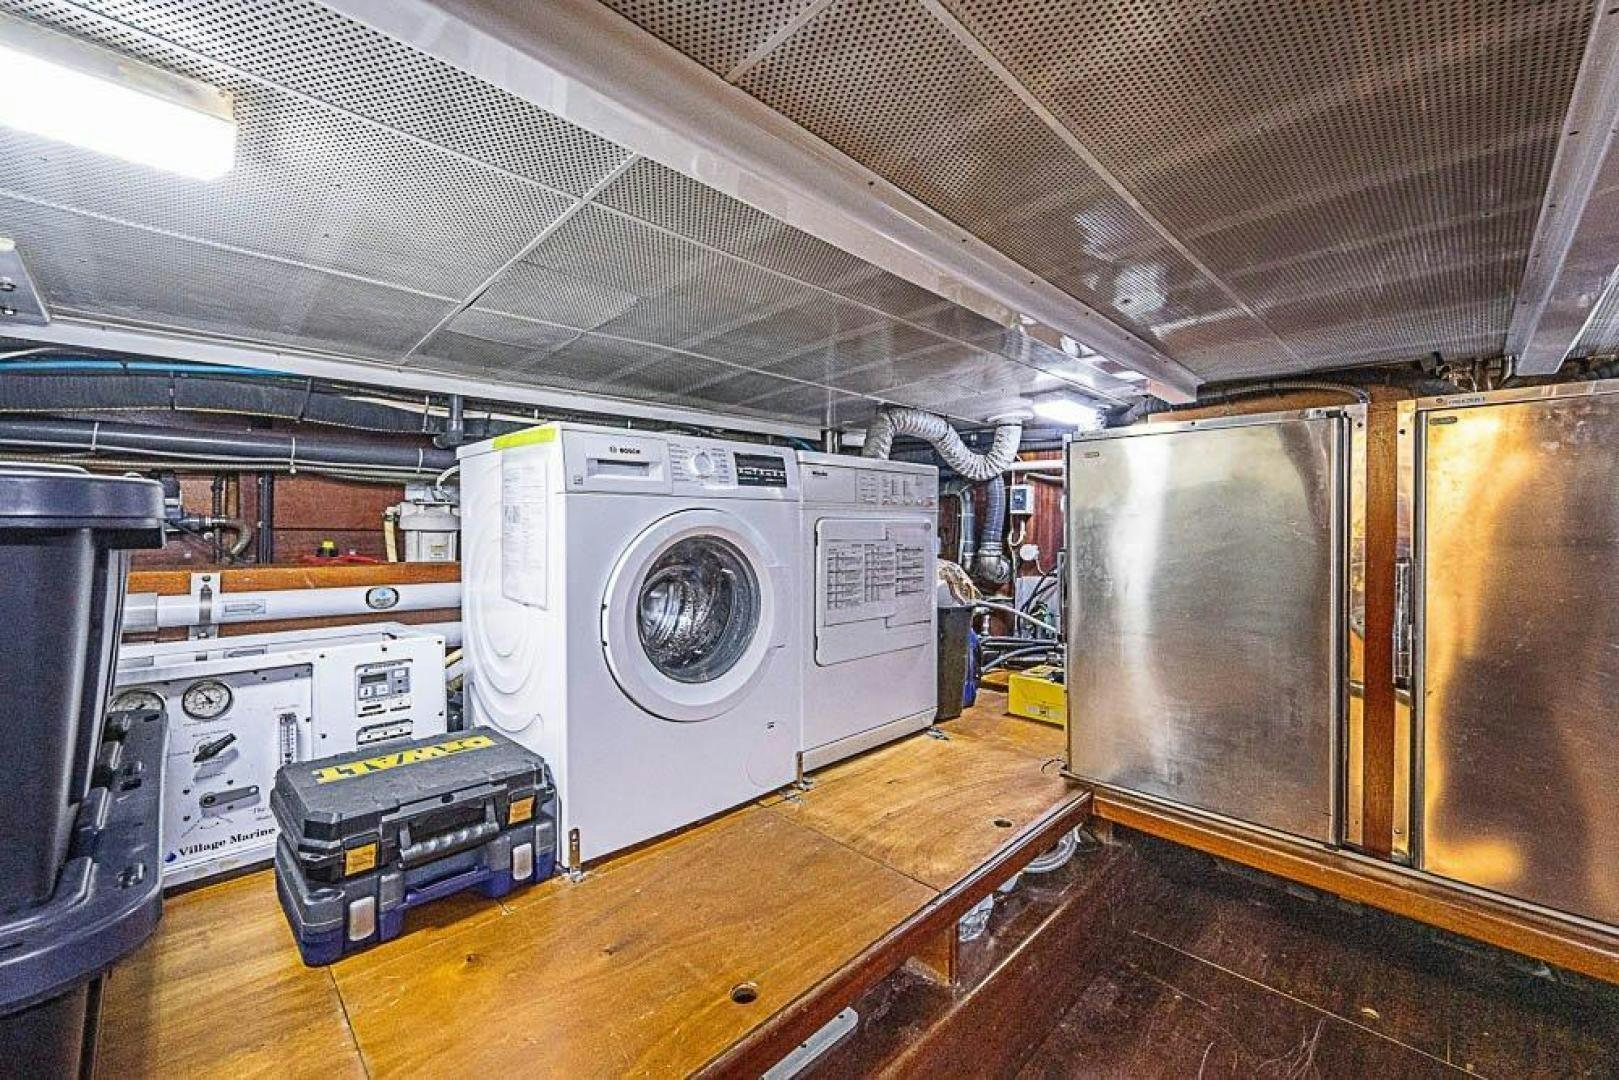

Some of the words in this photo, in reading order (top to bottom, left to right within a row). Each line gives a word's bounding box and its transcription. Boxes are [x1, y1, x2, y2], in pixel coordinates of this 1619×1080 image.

[619, 446, 641, 455] BOSCH
[179, 839, 226, 856] Village
[230, 827, 276, 844] Marine
